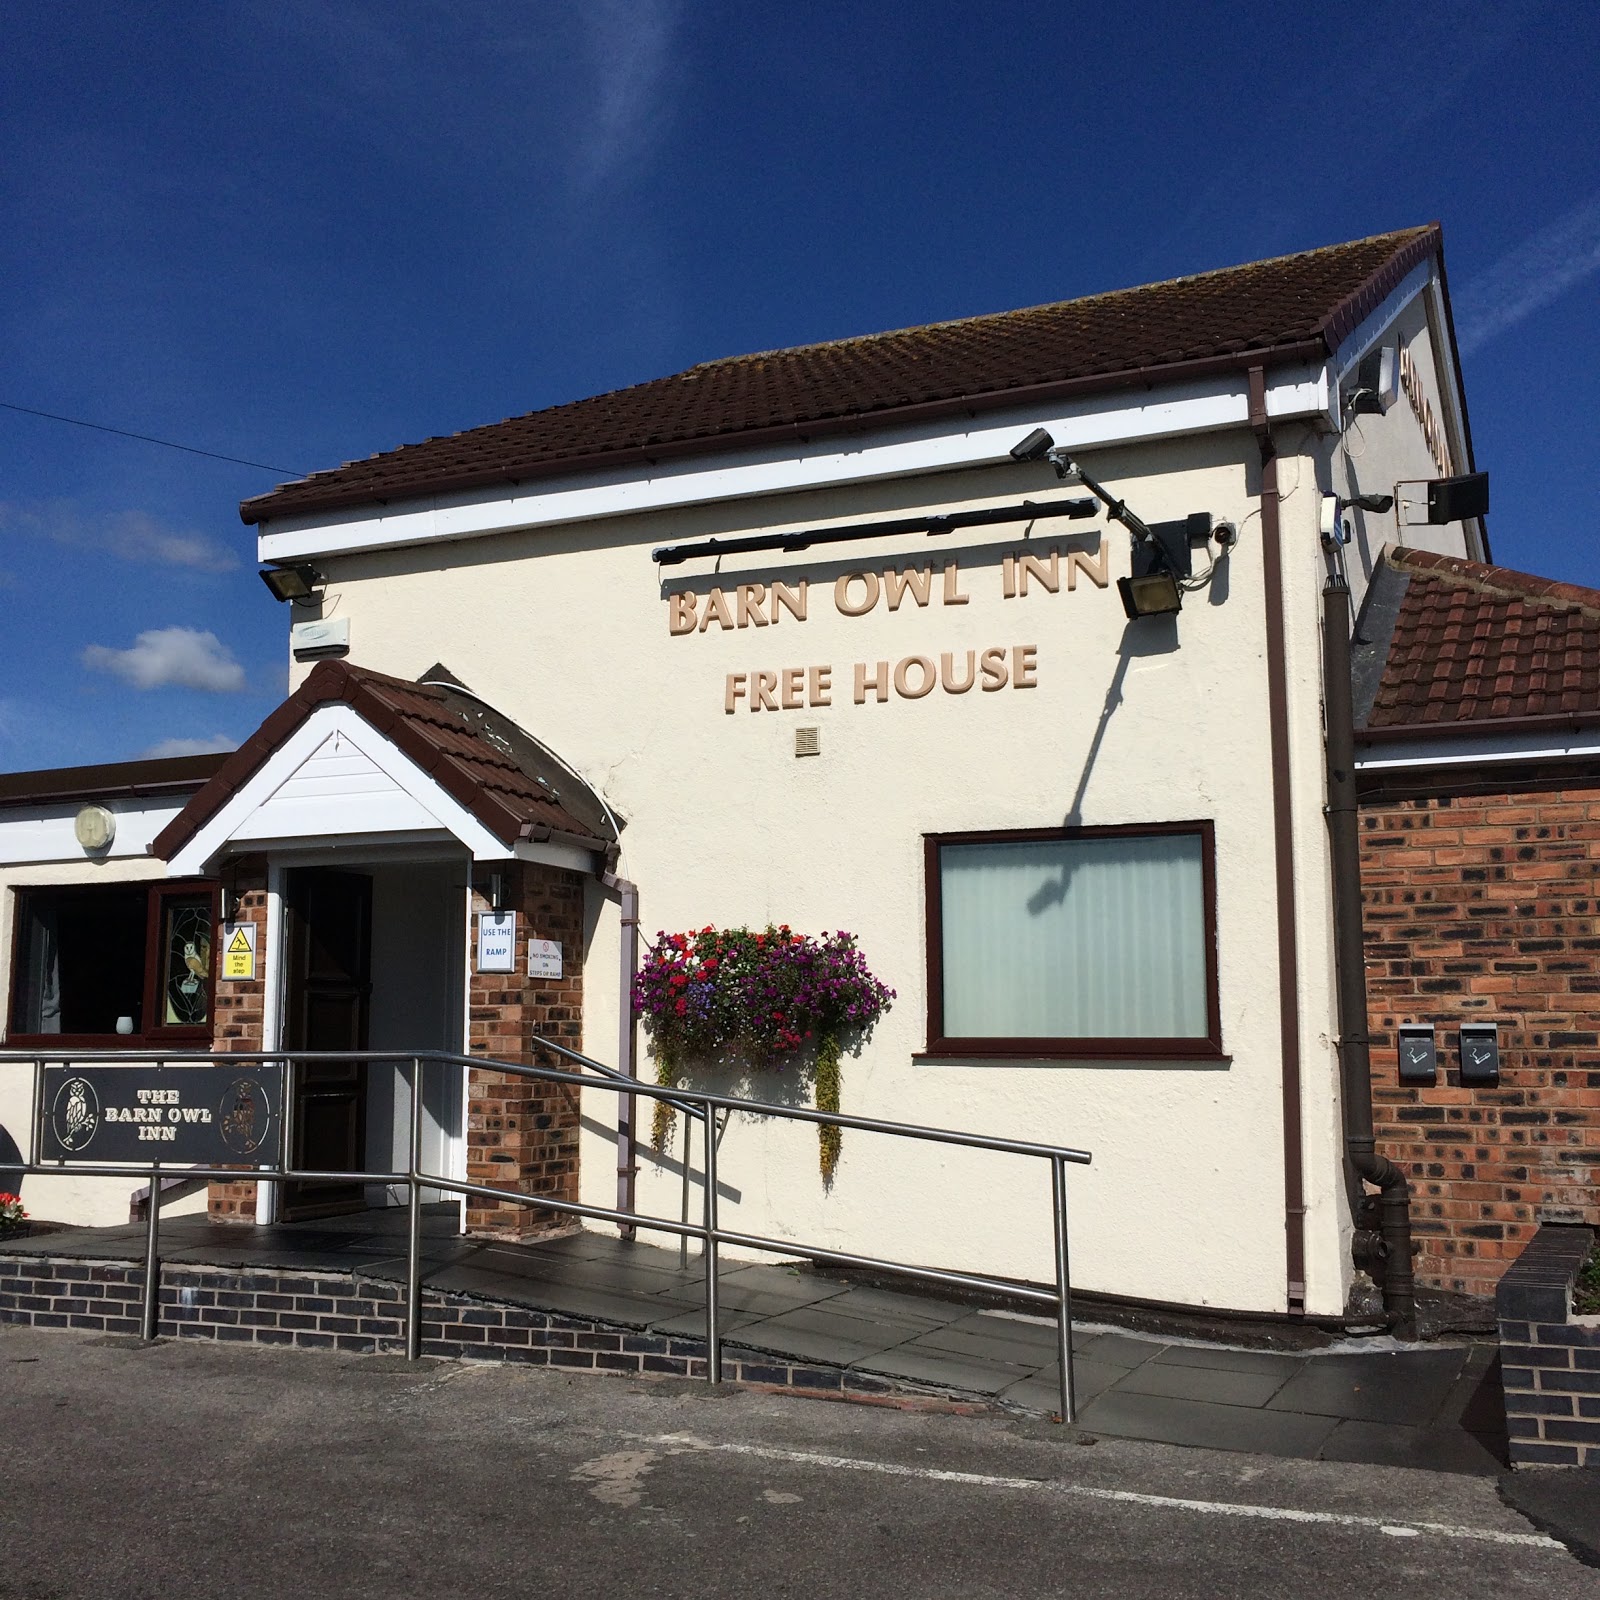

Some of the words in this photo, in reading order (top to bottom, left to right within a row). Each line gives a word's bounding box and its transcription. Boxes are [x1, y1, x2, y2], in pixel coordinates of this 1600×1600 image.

[669, 577, 808, 636] BARN
[834, 558, 969, 616] OWL
[1002, 540, 1109, 599] INN
[725, 664, 832, 714] FREE
[853, 644, 1038, 704] HOUSE
[498, 928, 511, 936] THE
[486, 948, 507, 956] RAMP
[137, 1090, 180, 1104] THE
[105, 1107, 163, 1123] BARN
[168, 1108, 212, 1123] OWL
[138, 1126, 177, 1141] INN
